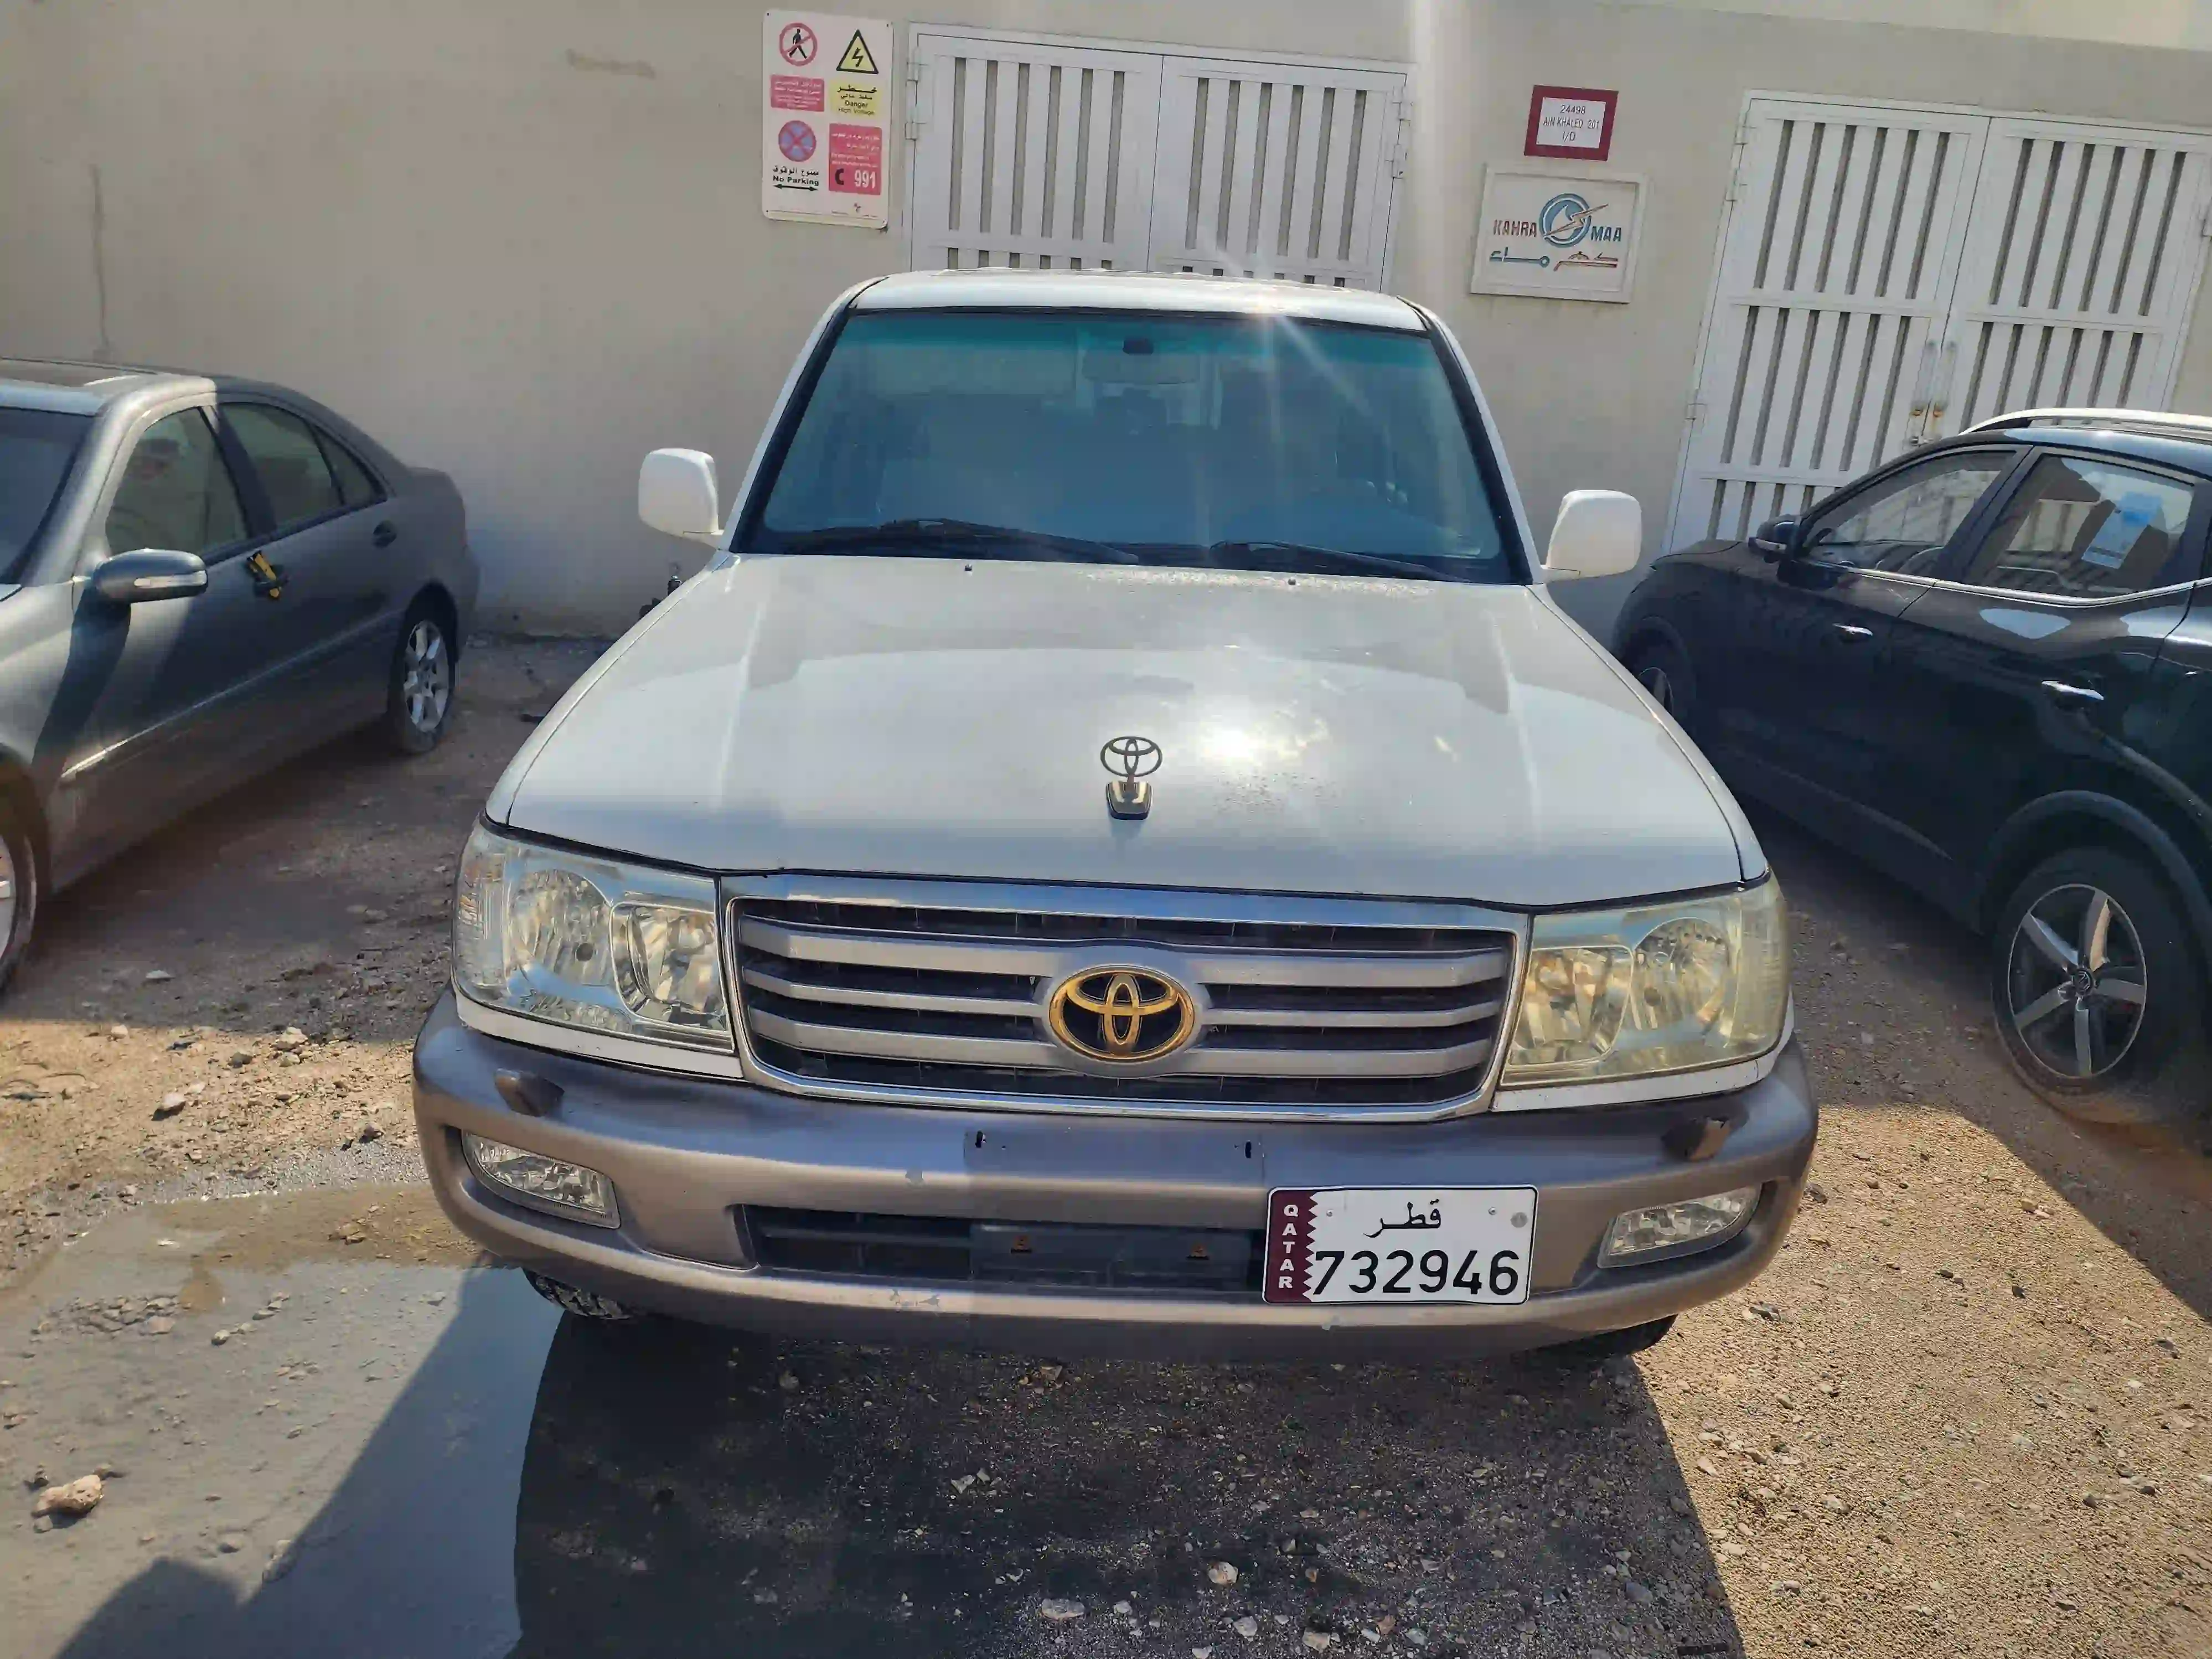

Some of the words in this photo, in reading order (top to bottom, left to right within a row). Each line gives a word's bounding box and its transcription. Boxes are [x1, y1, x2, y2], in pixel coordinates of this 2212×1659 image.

[836, 84, 877, 94] خطر
[845, 100, 869, 108] Danger
[1560, 104, 1586, 115] 24498
[1543, 117, 1556, 127] AIN
[1557, 117, 1584, 129] KHALED
[1587, 119, 1600, 130] 201
[787, 177, 819, 187] Parking
[854, 170, 876, 189] 991
[1493, 219, 1538, 238] KAHRA
[1590, 225, 1622, 242] MAA
[1363, 1197, 1442, 1238] قطر
[1278, 1204, 1299, 1289] QATAR
[1312, 1248, 1521, 1296] 732946
